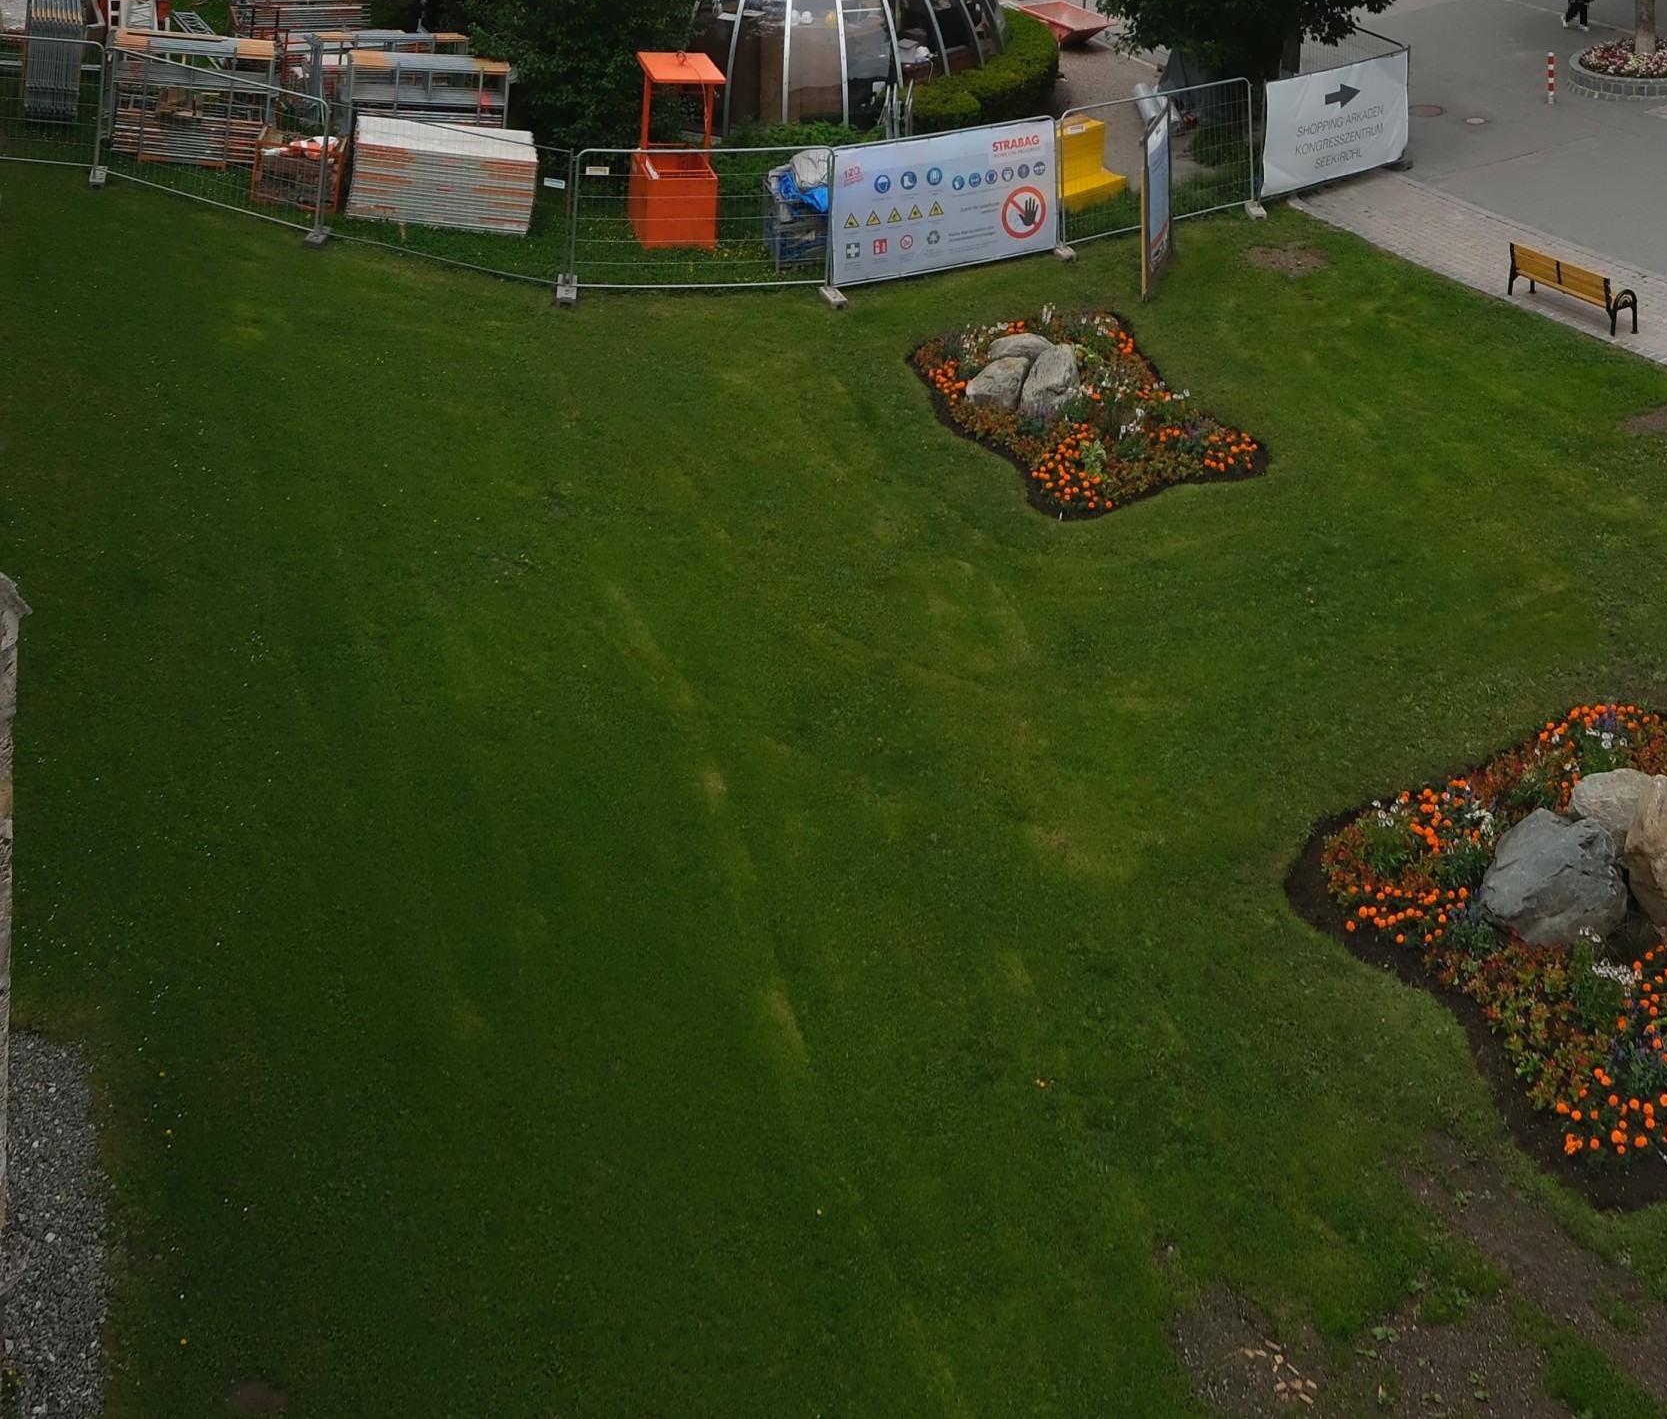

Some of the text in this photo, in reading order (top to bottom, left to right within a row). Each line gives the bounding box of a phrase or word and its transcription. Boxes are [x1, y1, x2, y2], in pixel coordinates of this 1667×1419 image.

[1297, 105, 1384, 138] SHOPPING ARKADEN
[992, 135, 1040, 152] STRABAG
[1295, 123, 1384, 156] KONGRESSZENTRUM
[1314, 148, 1363, 169] SEEKIRCHL
